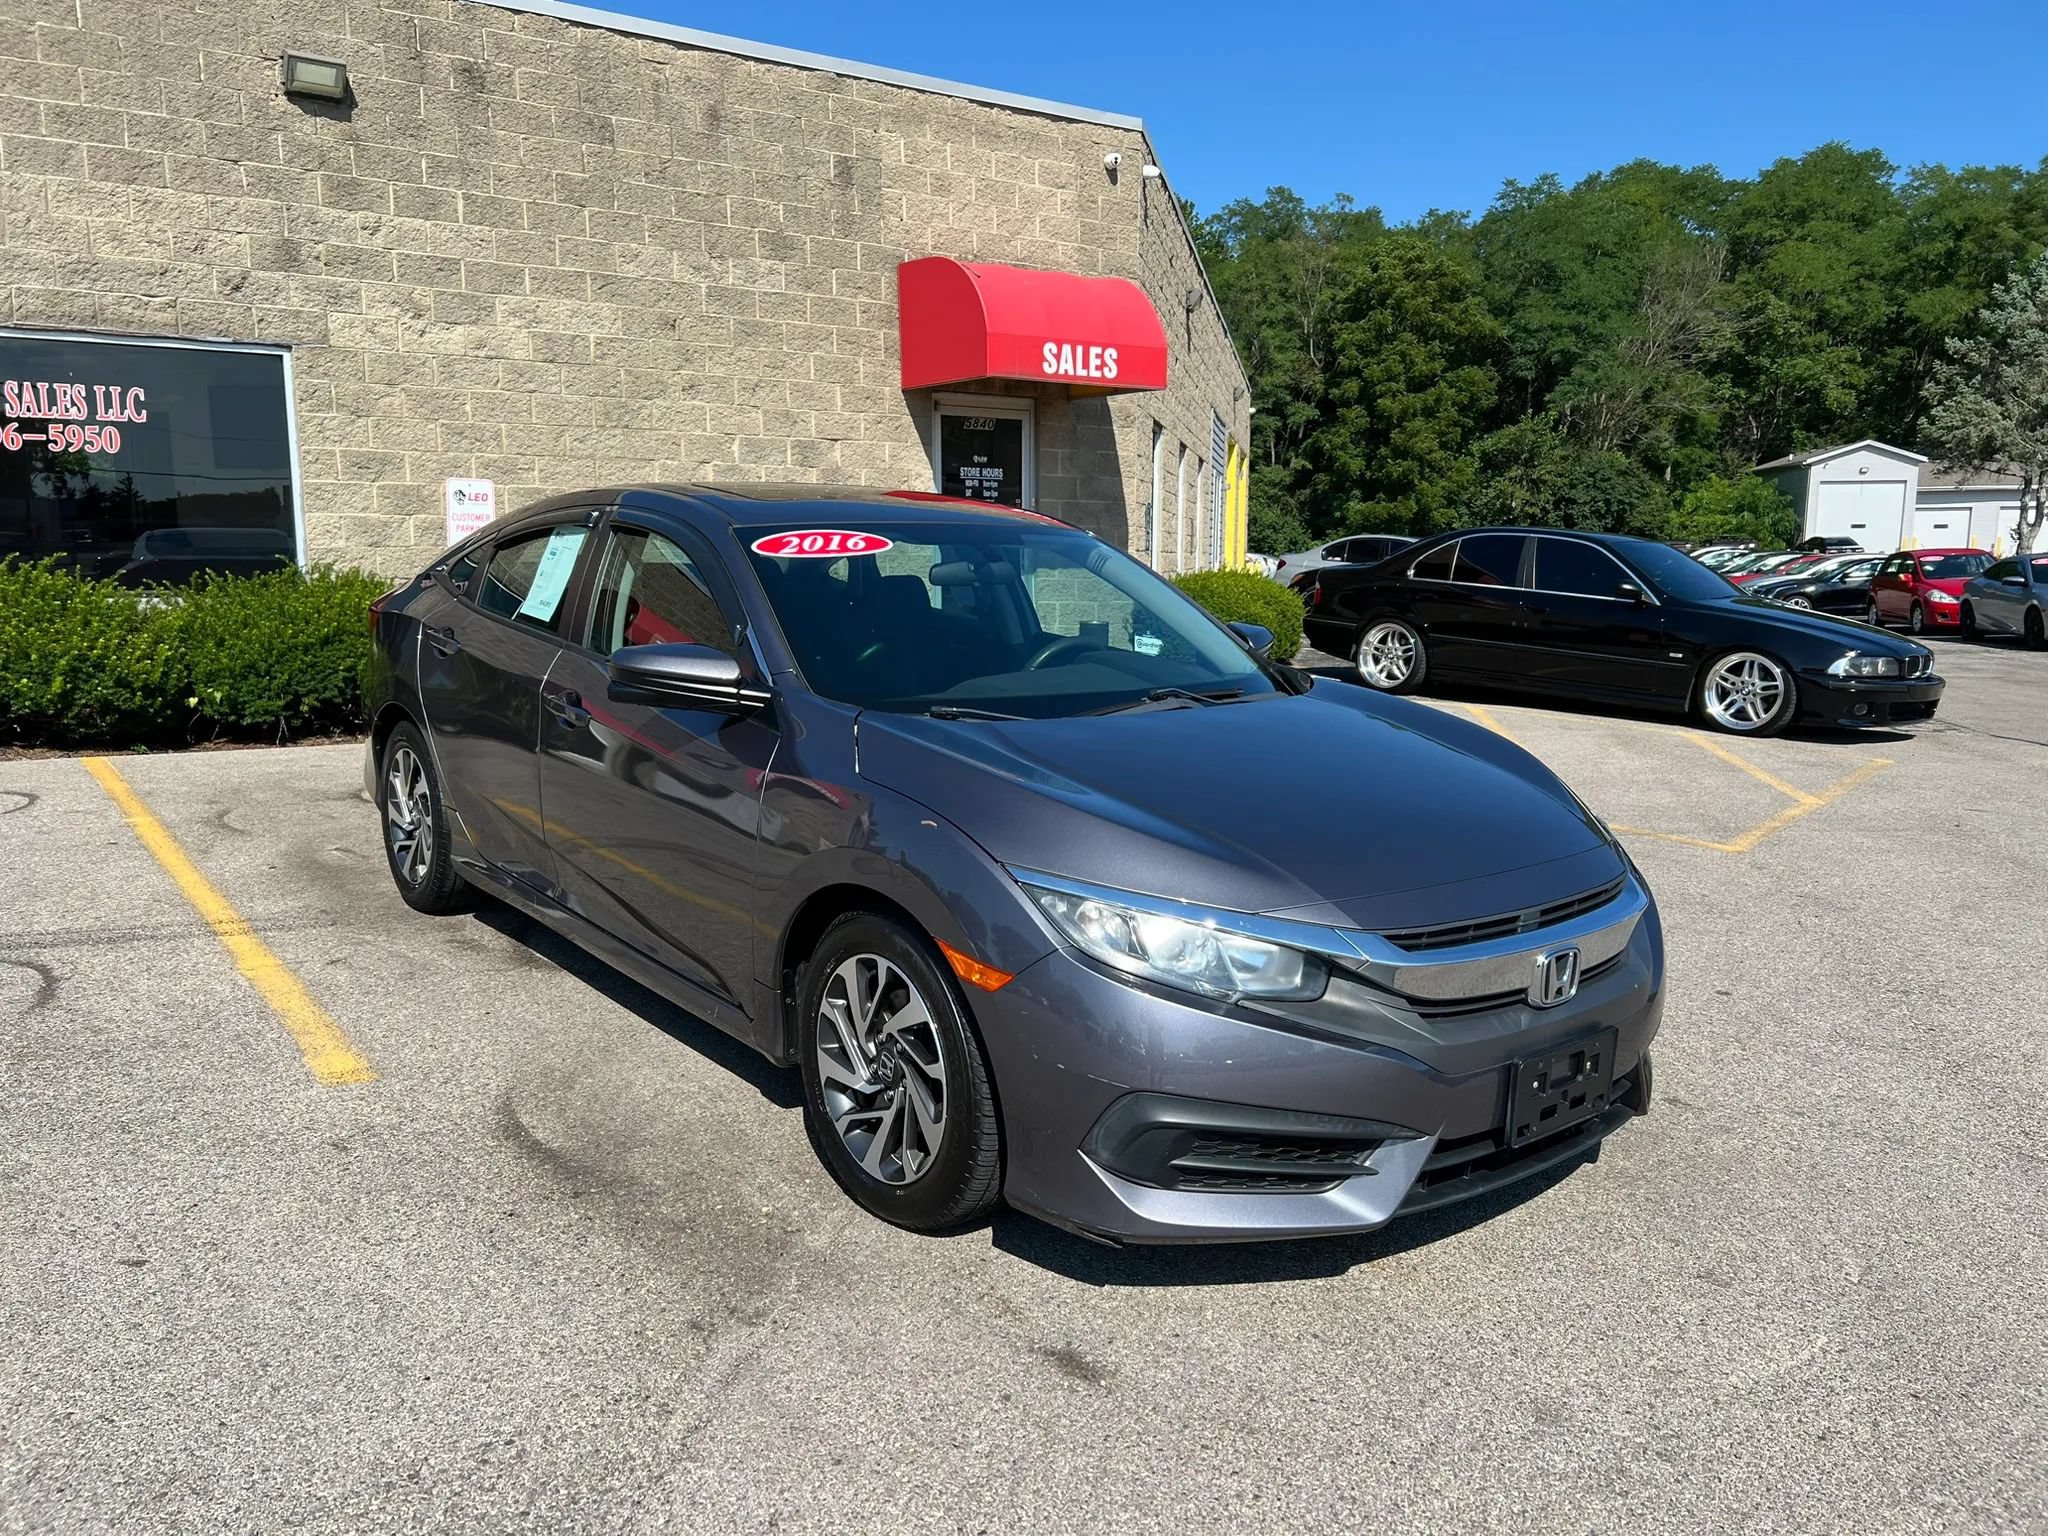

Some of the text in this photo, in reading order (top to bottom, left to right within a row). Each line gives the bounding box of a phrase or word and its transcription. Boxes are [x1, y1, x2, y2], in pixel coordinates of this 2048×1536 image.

[1042, 341, 1118, 379] SALES
[4, 380, 147, 423] SALES LLC
[965, 418, 995, 430] 5840
[0, 422, 121, 454] 6-5950
[960, 467, 1004, 478] STORE HOURS
[468, 492, 489, 502] LEO
[451, 512, 491, 522] CUSTOMER
[778, 535, 868, 554] 2016
